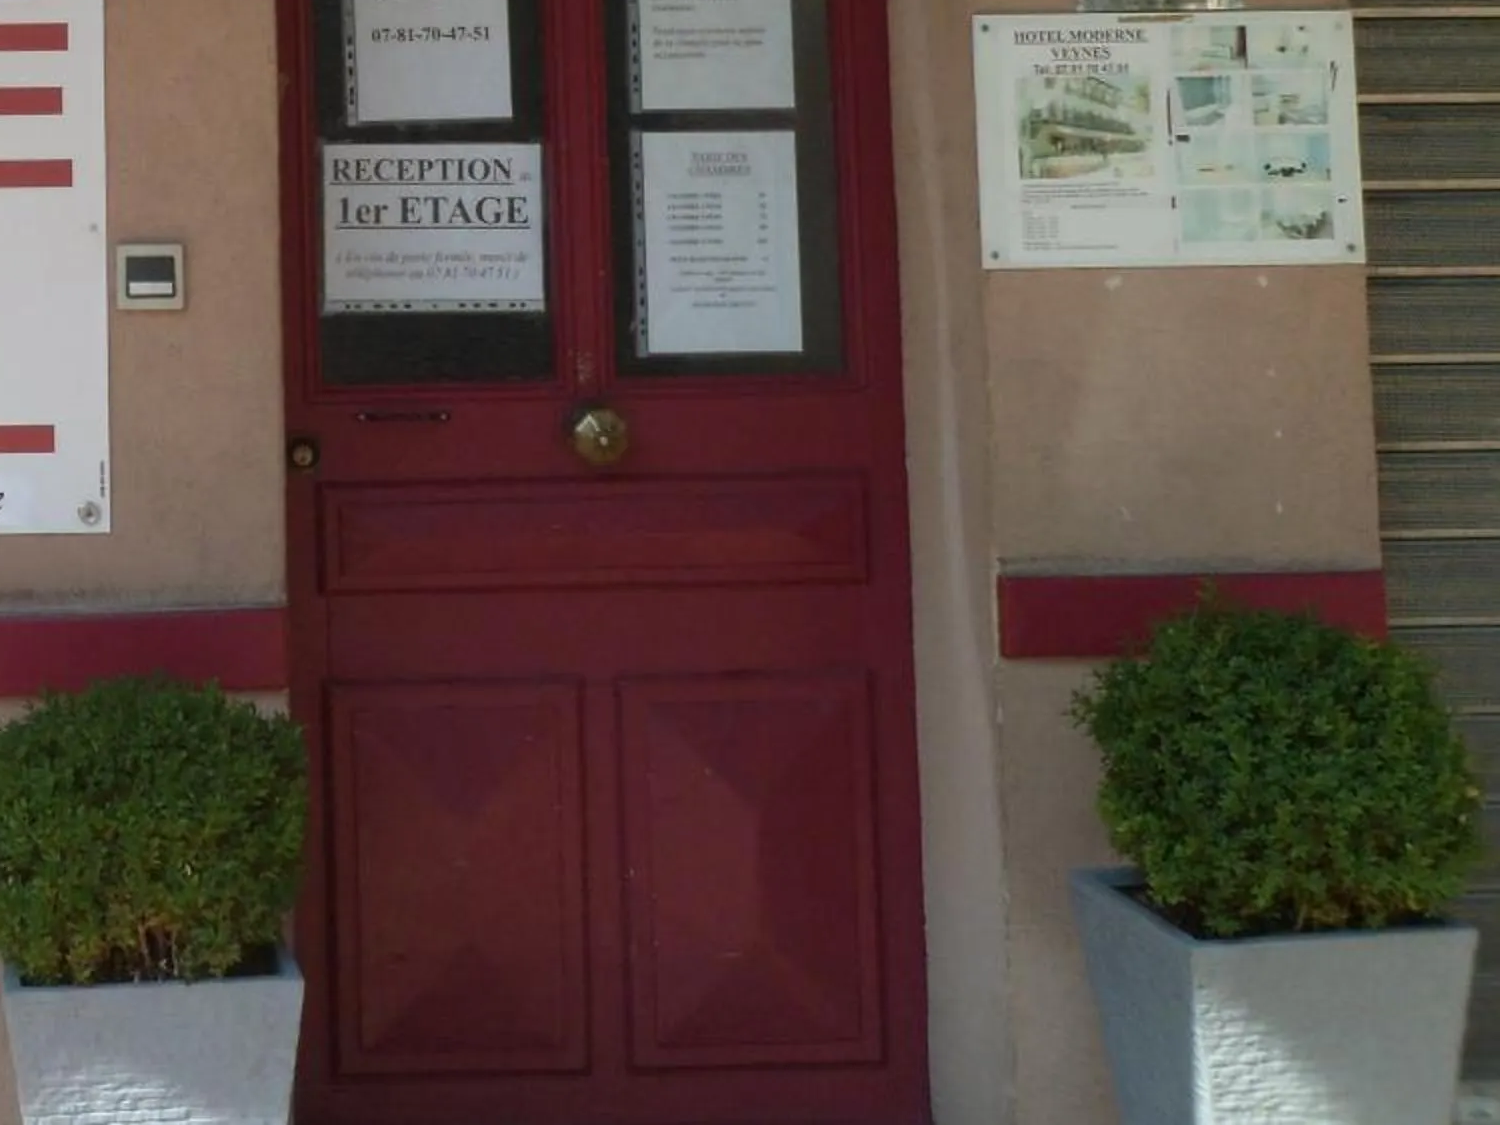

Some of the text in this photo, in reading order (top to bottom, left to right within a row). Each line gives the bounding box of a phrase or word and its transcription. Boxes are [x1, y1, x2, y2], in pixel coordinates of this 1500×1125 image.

[371, 26, 489, 43] 07-81-70-47-51
[1014, 29, 1065, 44] HOTEL
[332, 157, 513, 181] RECEPTION
[340, 195, 529, 225] 1er ETAGE
